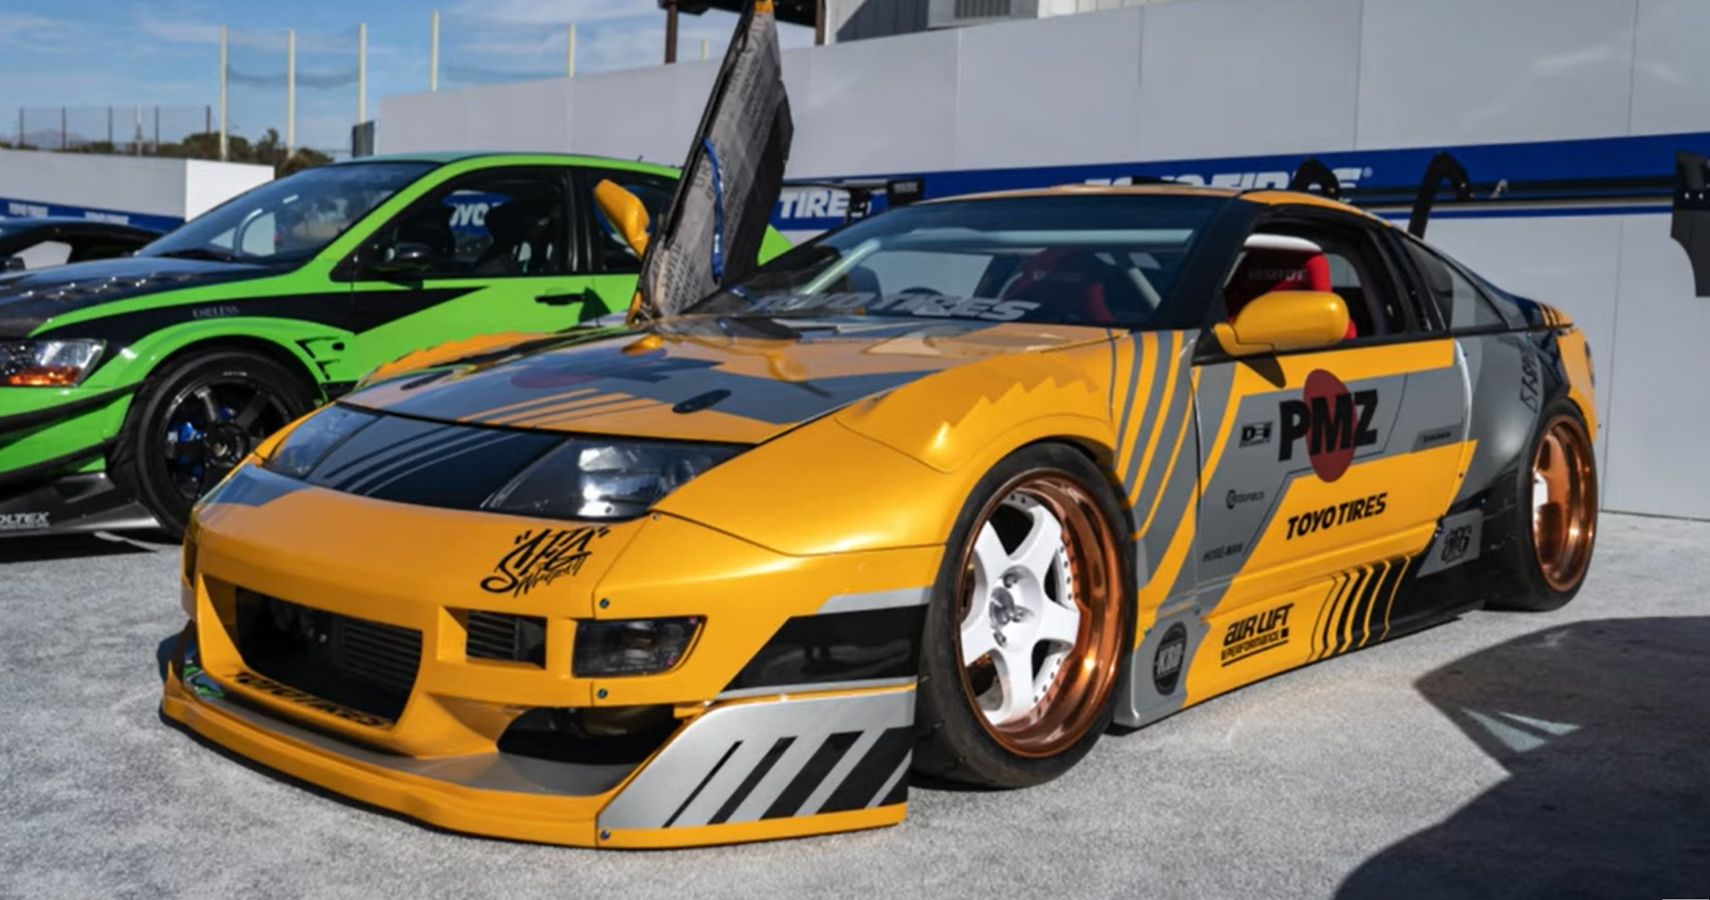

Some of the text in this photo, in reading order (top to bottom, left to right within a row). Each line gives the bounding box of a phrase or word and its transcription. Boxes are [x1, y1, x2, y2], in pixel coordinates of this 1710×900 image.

[780, 187, 871, 218] TIRE
[873, 292, 1041, 321] TIRES
[1278, 389, 1378, 462] PMZ
